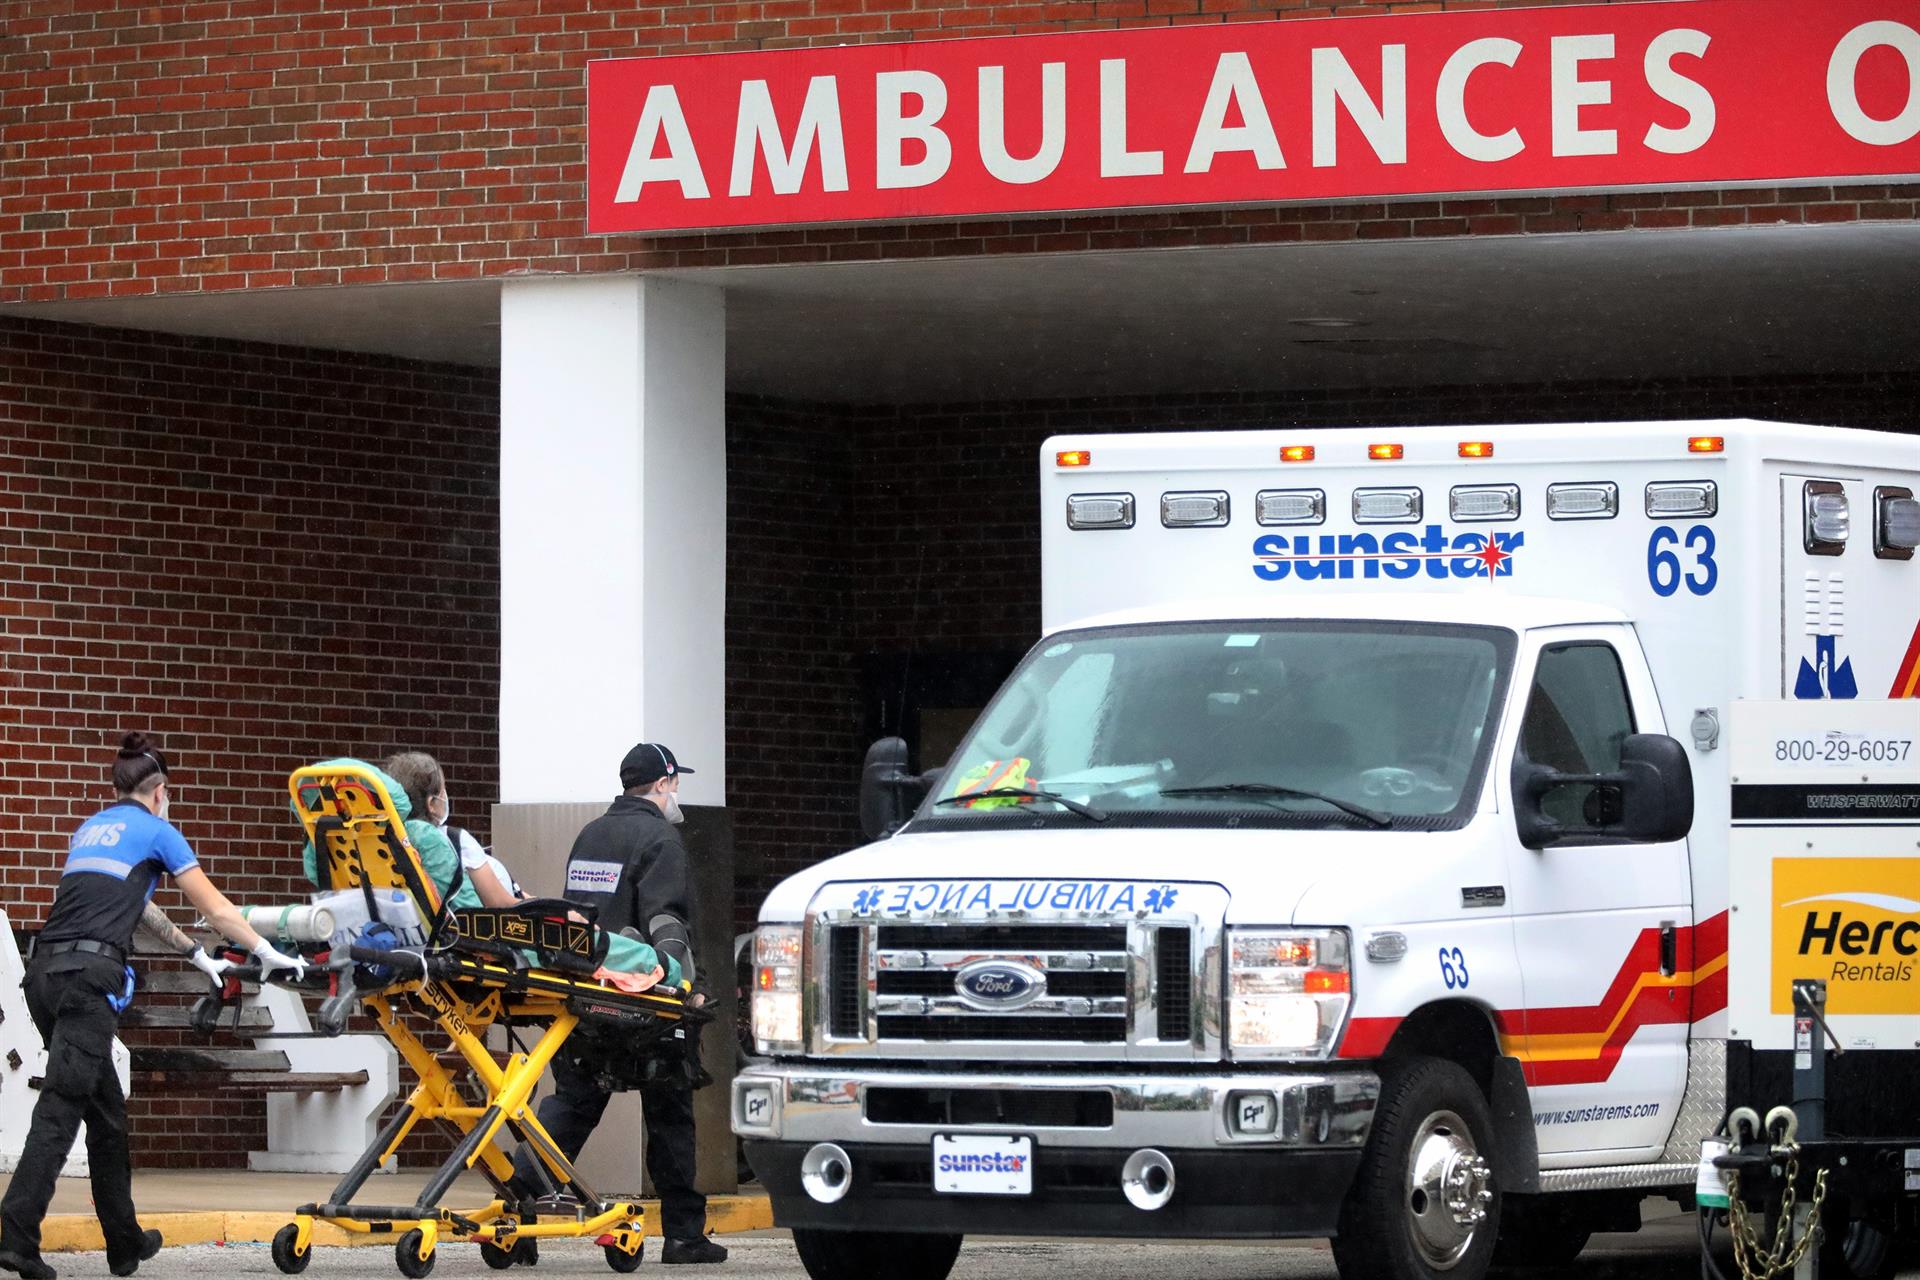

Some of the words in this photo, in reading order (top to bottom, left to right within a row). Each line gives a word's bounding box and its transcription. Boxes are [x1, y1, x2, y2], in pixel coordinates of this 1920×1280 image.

[614, 28, 1716, 204] AMBULANCES
[1252, 525, 1524, 583] sunstar
[1647, 525, 1718, 597] 63
[1775, 740, 1912, 761] 800-29-6057
[1806, 794, 1920, 808] WHISPERWATT
[505, 921, 528, 936] XPS
[1798, 911, 1920, 956] Herc
[1439, 947, 1469, 989] 63
[1831, 961, 1912, 981] Rentals
[975, 973, 1015, 993] Ford
[424, 982, 468, 1036] stryker
[1534, 1103, 1660, 1126] www.sunstarems.com
[938, 1151, 1027, 1173] sunstar
